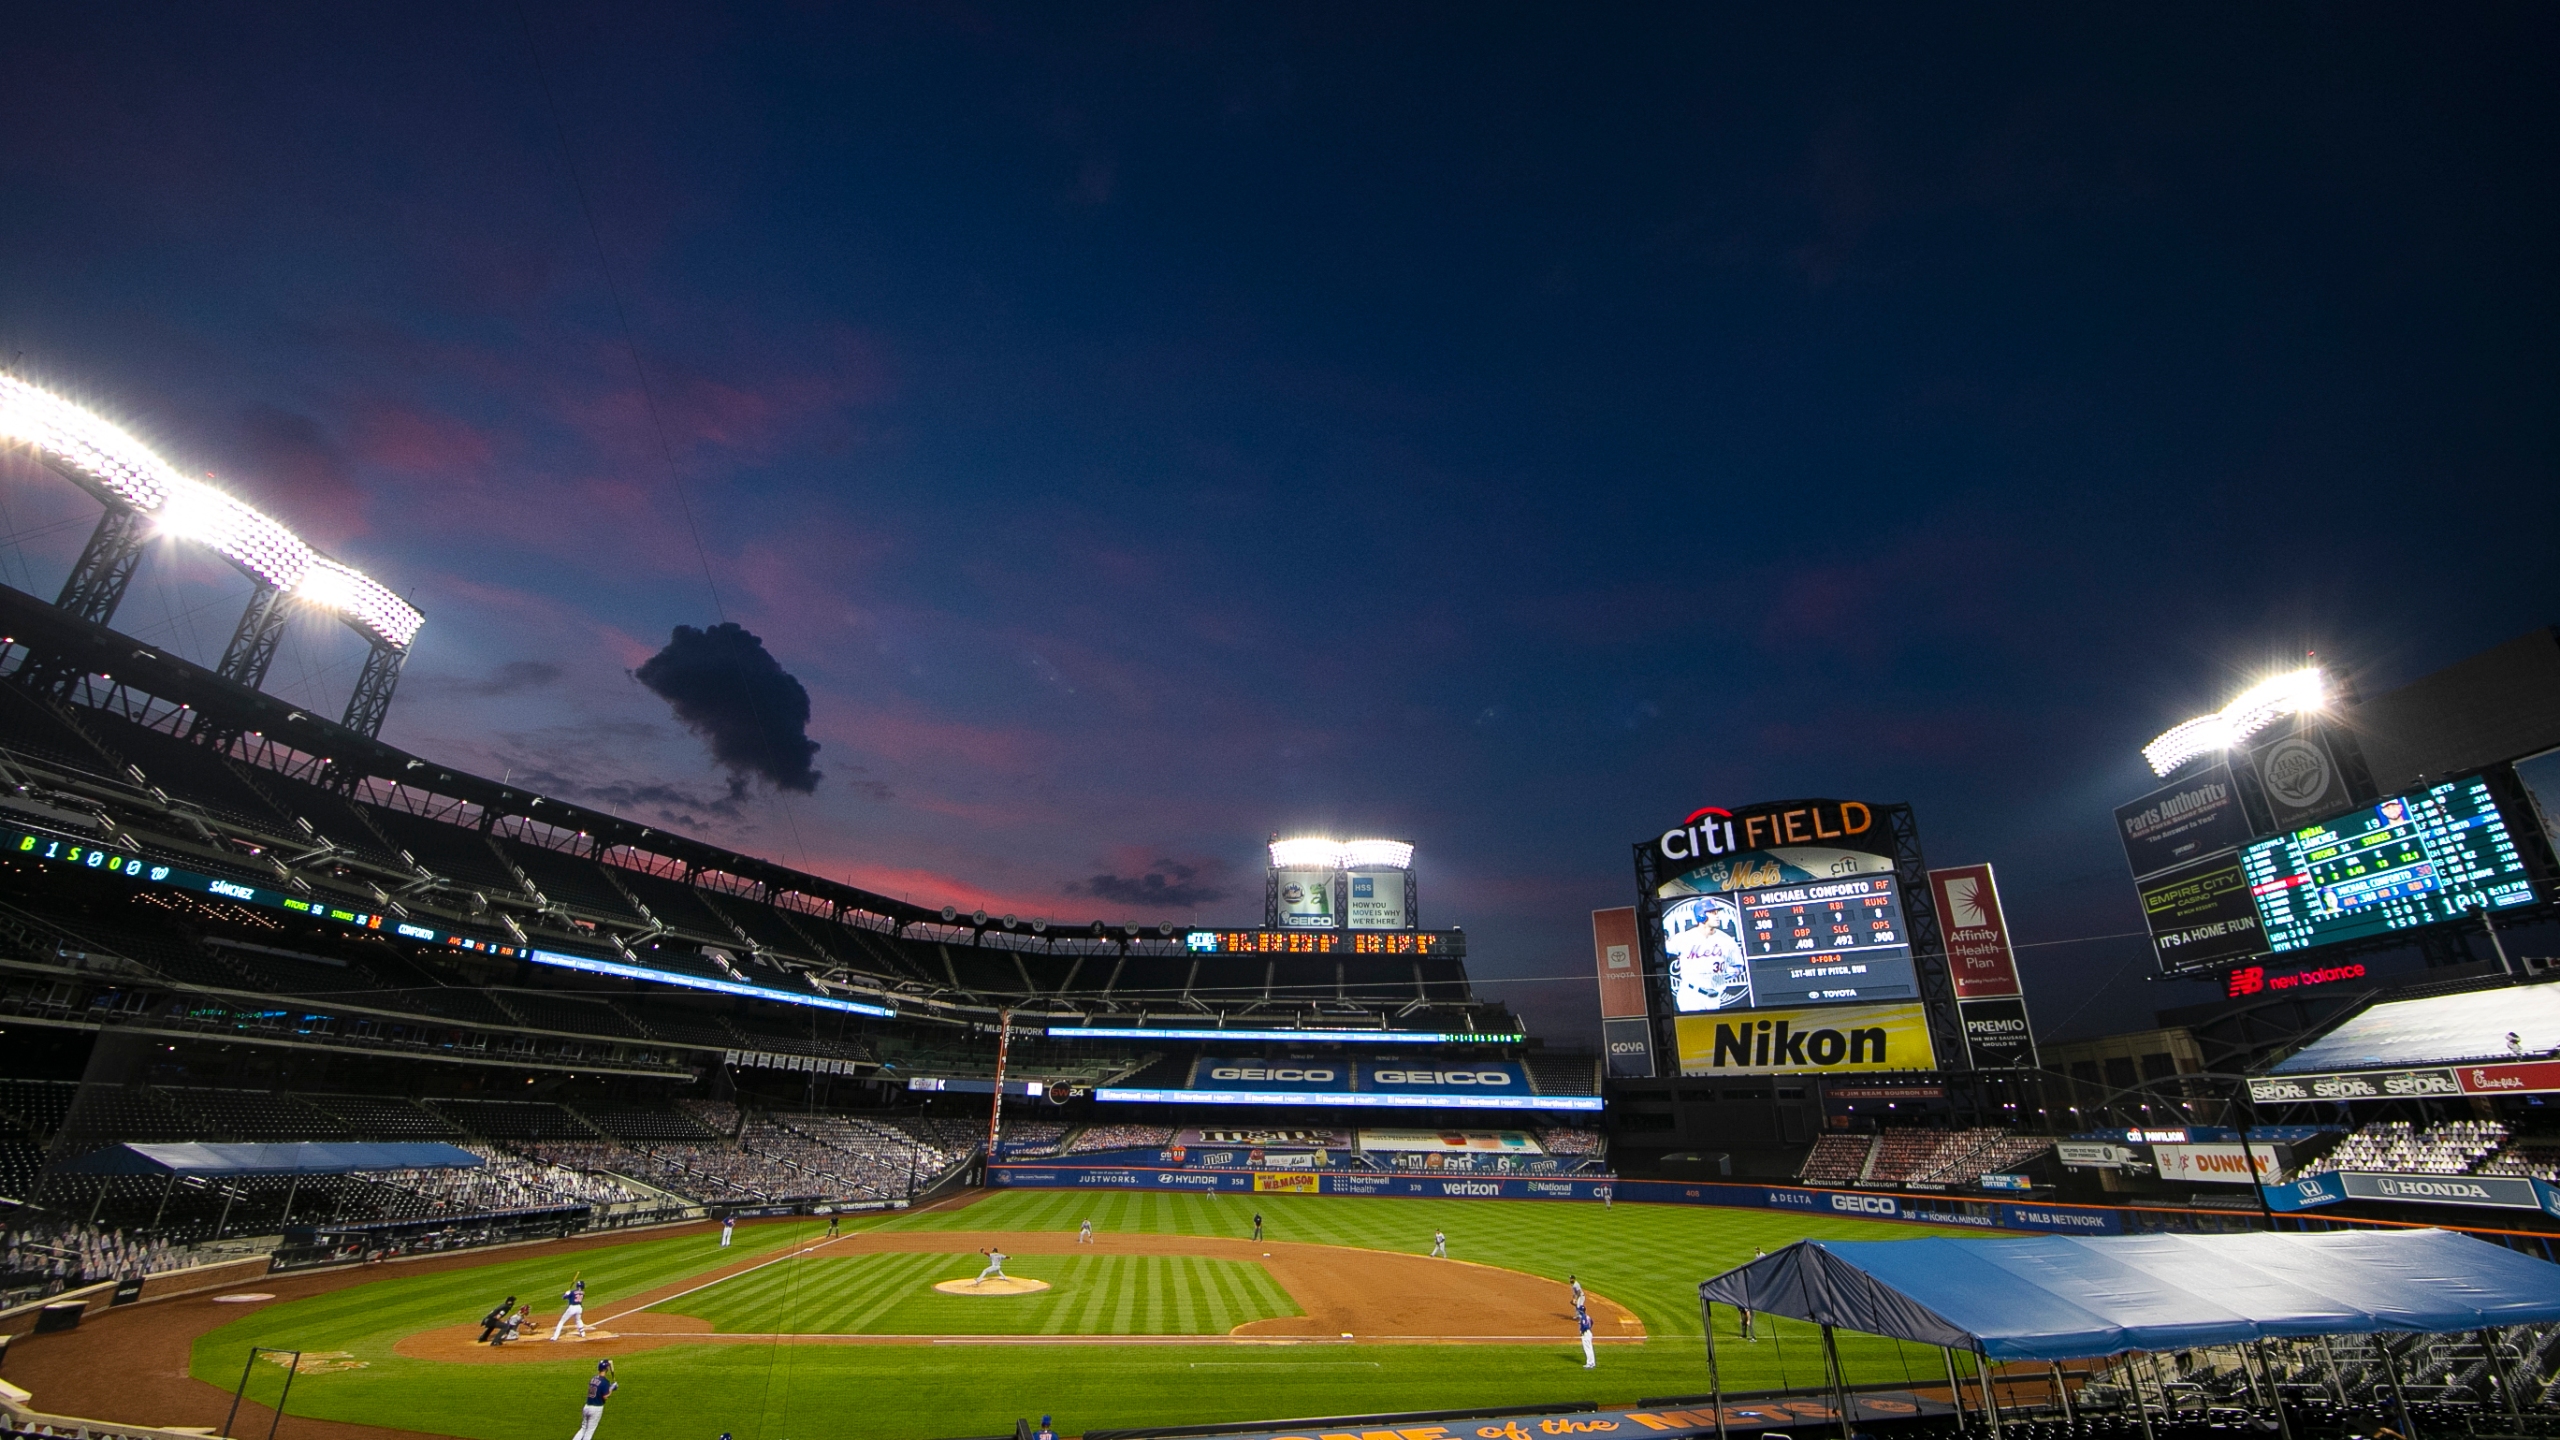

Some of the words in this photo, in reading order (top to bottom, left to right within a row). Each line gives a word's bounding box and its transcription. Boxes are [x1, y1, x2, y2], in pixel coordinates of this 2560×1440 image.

[2430, 783, 2455, 796] METS
[2125, 808, 2159, 834] Parts
[2160, 782, 2227, 820] Authority
[1660, 815, 1736, 861] citi
[1744, 801, 1873, 849] FIELD
[2364, 818, 2380, 830] 19
[20, 836, 36, 850] B
[46, 842, 59, 857] 1
[67, 847, 82, 861] S
[1692, 861, 1726, 880] LET'S
[1830, 858, 1858, 876] citi
[1712, 870, 1729, 883] GO
[1722, 859, 1782, 891] Mets
[209, 880, 254, 900] SÁNCHEZ
[1355, 884, 1372, 892] HSS
[1760, 889, 1808, 905] MICHAEL
[1809, 881, 1870, 899] CONFORTO
[1874, 879, 1889, 891] RF
[2510, 880, 2530, 891] PM
[2149, 884, 2201, 906] EMPIRE
[2178, 892, 2211, 907] CASINO
[284, 898, 310, 912] PITCHES
[311, 904, 323, 915] 56
[331, 909, 354, 922] STRIKES
[356, 915, 367, 925] 35
[1754, 910, 1770, 919] AVG
[1792, 906, 1805, 914] HR
[1828, 902, 1844, 911] RBI
[1864, 897, 1889, 907] RUNS
[976, 914, 984, 922] 41
[1006, 918, 1014, 926] 14
[1288, 916, 1332, 926] GEICO
[1797, 916, 1804, 926] 3
[1834, 911, 1842, 922] 9
[1874, 907, 1883, 919] 8
[398, 924, 434, 940] CONFORTO
[1035, 921, 1044, 929] 37
[1161, 924, 1170, 932] 42
[1759, 932, 1771, 941] BB
[1794, 928, 1811, 937] OBP
[1832, 925, 1850, 934] SLG
[1872, 921, 1890, 930] OPS
[2159, 934, 2181, 948] IT'S
[2182, 931, 2191, 944] A
[2191, 922, 2227, 942] HOME
[2229, 916, 2256, 933] RUN
[1763, 941, 1771, 952] 9
[1833, 935, 1854, 946] .492
[1873, 931, 1895, 943] .900
[1951, 930, 1998, 943] Affinity
[448, 936, 462, 945] AVG
[475, 942, 485, 951] HR
[490, 944, 497, 954] 3
[500, 946, 514, 956] RBI
[1686, 943, 1723, 960] Mets
[1955, 943, 1999, 956] Health
[1966, 957, 1995, 969] Plan
[1606, 971, 1636, 980] TOYOTA
[2269, 976, 2299, 990] new
[2300, 963, 2366, 985] balance
[1823, 989, 1857, 999] TOYOTA
[984, 1024, 1002, 1032] MLB
[1967, 1019, 2025, 1032] PREMIO
[1611, 1042, 1645, 1053] GOYA
[1712, 1020, 1888, 1068] Nikon
[1211, 1067, 1334, 1082] GEICO
[1374, 1070, 1511, 1085] GEICO
[2252, 1085, 2307, 1099] SPDRs
[2313, 1081, 2377, 1097] SPDRs
[2384, 1077, 2456, 1094] SPDRs
[2127, 1131, 2142, 1142] citi
[2144, 1131, 2186, 1142] PAVILION
[1175, 1174, 1217, 1184] HYUNDAI
[1350, 1176, 1390, 1185] Northwell
[1350, 1184, 1376, 1193] Health
[1443, 1181, 1499, 1195] verizon
[1537, 1182, 1571, 1192] National
[1686, 1189, 1700, 1197] 408
[2397, 1182, 2491, 1198] HONDA
[1779, 1193, 1812, 1205] DELTA
[1831, 1194, 1896, 1215] GEICO
[2299, 1193, 2336, 1206] HONDA
[1903, 1210, 1915, 1219] 380
[1929, 1213, 1957, 1223] KONICA
[1958, 1214, 1992, 1226] MINOLTA
[2028, 1211, 2050, 1224] MLB
[2053, 1213, 2105, 1227] NETWORK
[1476, 1421, 1530, 1440] of
[1537, 1418, 1620, 1434] the
[1624, 1402, 1842, 1431] METS
